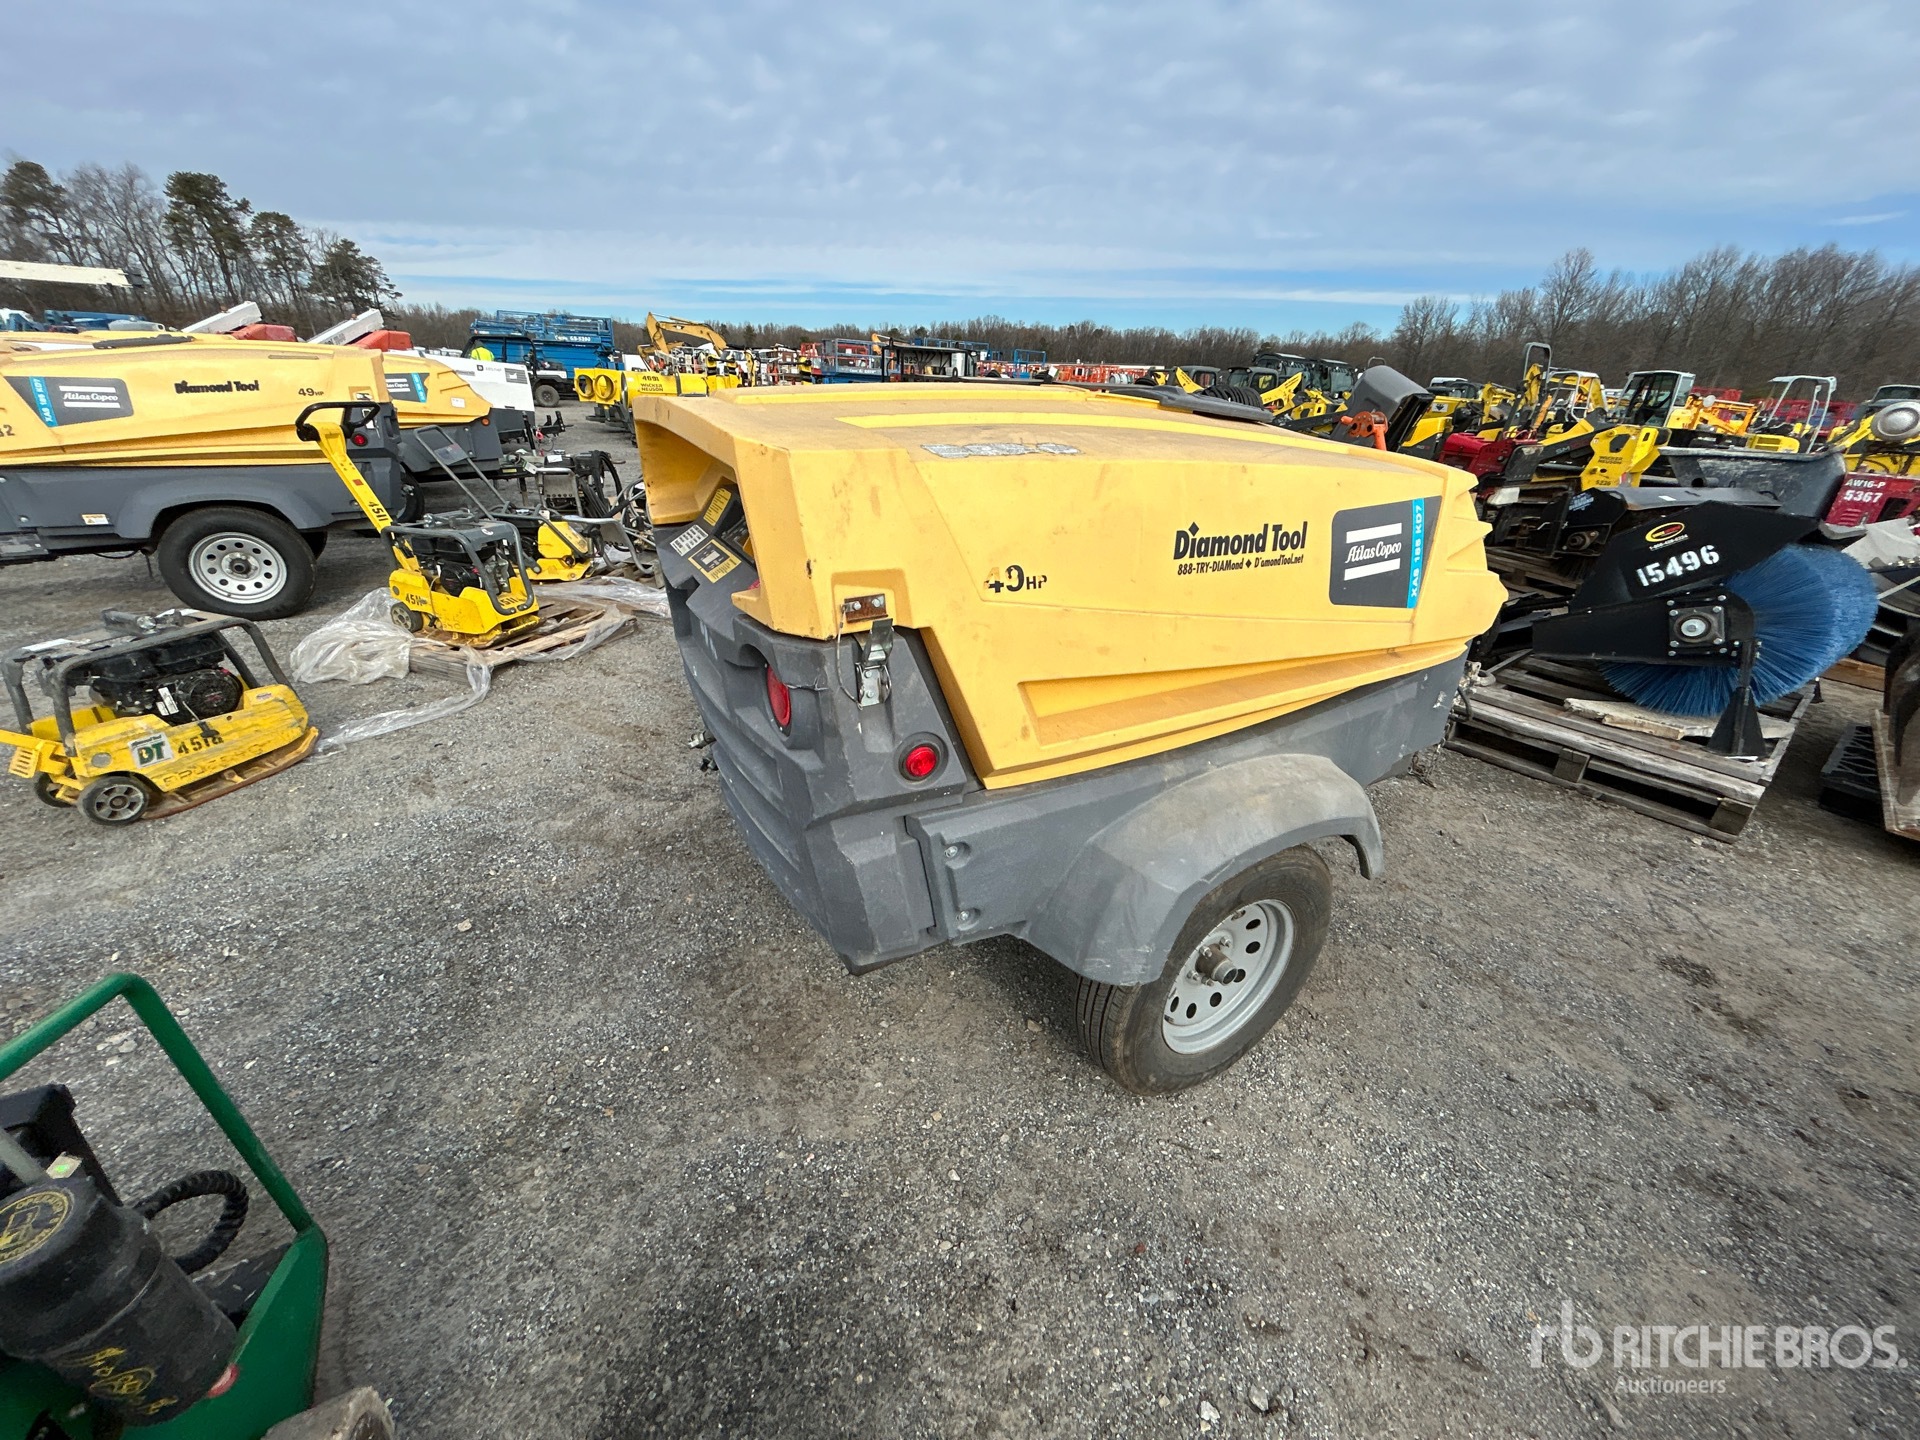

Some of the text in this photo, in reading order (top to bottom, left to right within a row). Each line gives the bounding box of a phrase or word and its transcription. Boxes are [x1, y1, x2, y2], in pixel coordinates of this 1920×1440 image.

[63, 392, 119, 402] Atlas Copco
[174, 380, 260, 394] Diamond Tool
[1845, 478, 1886, 489] AW16-P
[1843, 489, 1883, 503] 5367
[368, 502, 389, 522] 4511
[1415, 505, 1423, 534] KD7
[1173, 521, 1308, 560] Diamond Tool
[1344, 541, 1402, 564] Atlas Copco
[1636, 544, 1720, 587] 15496
[137, 741, 165, 765] DT
